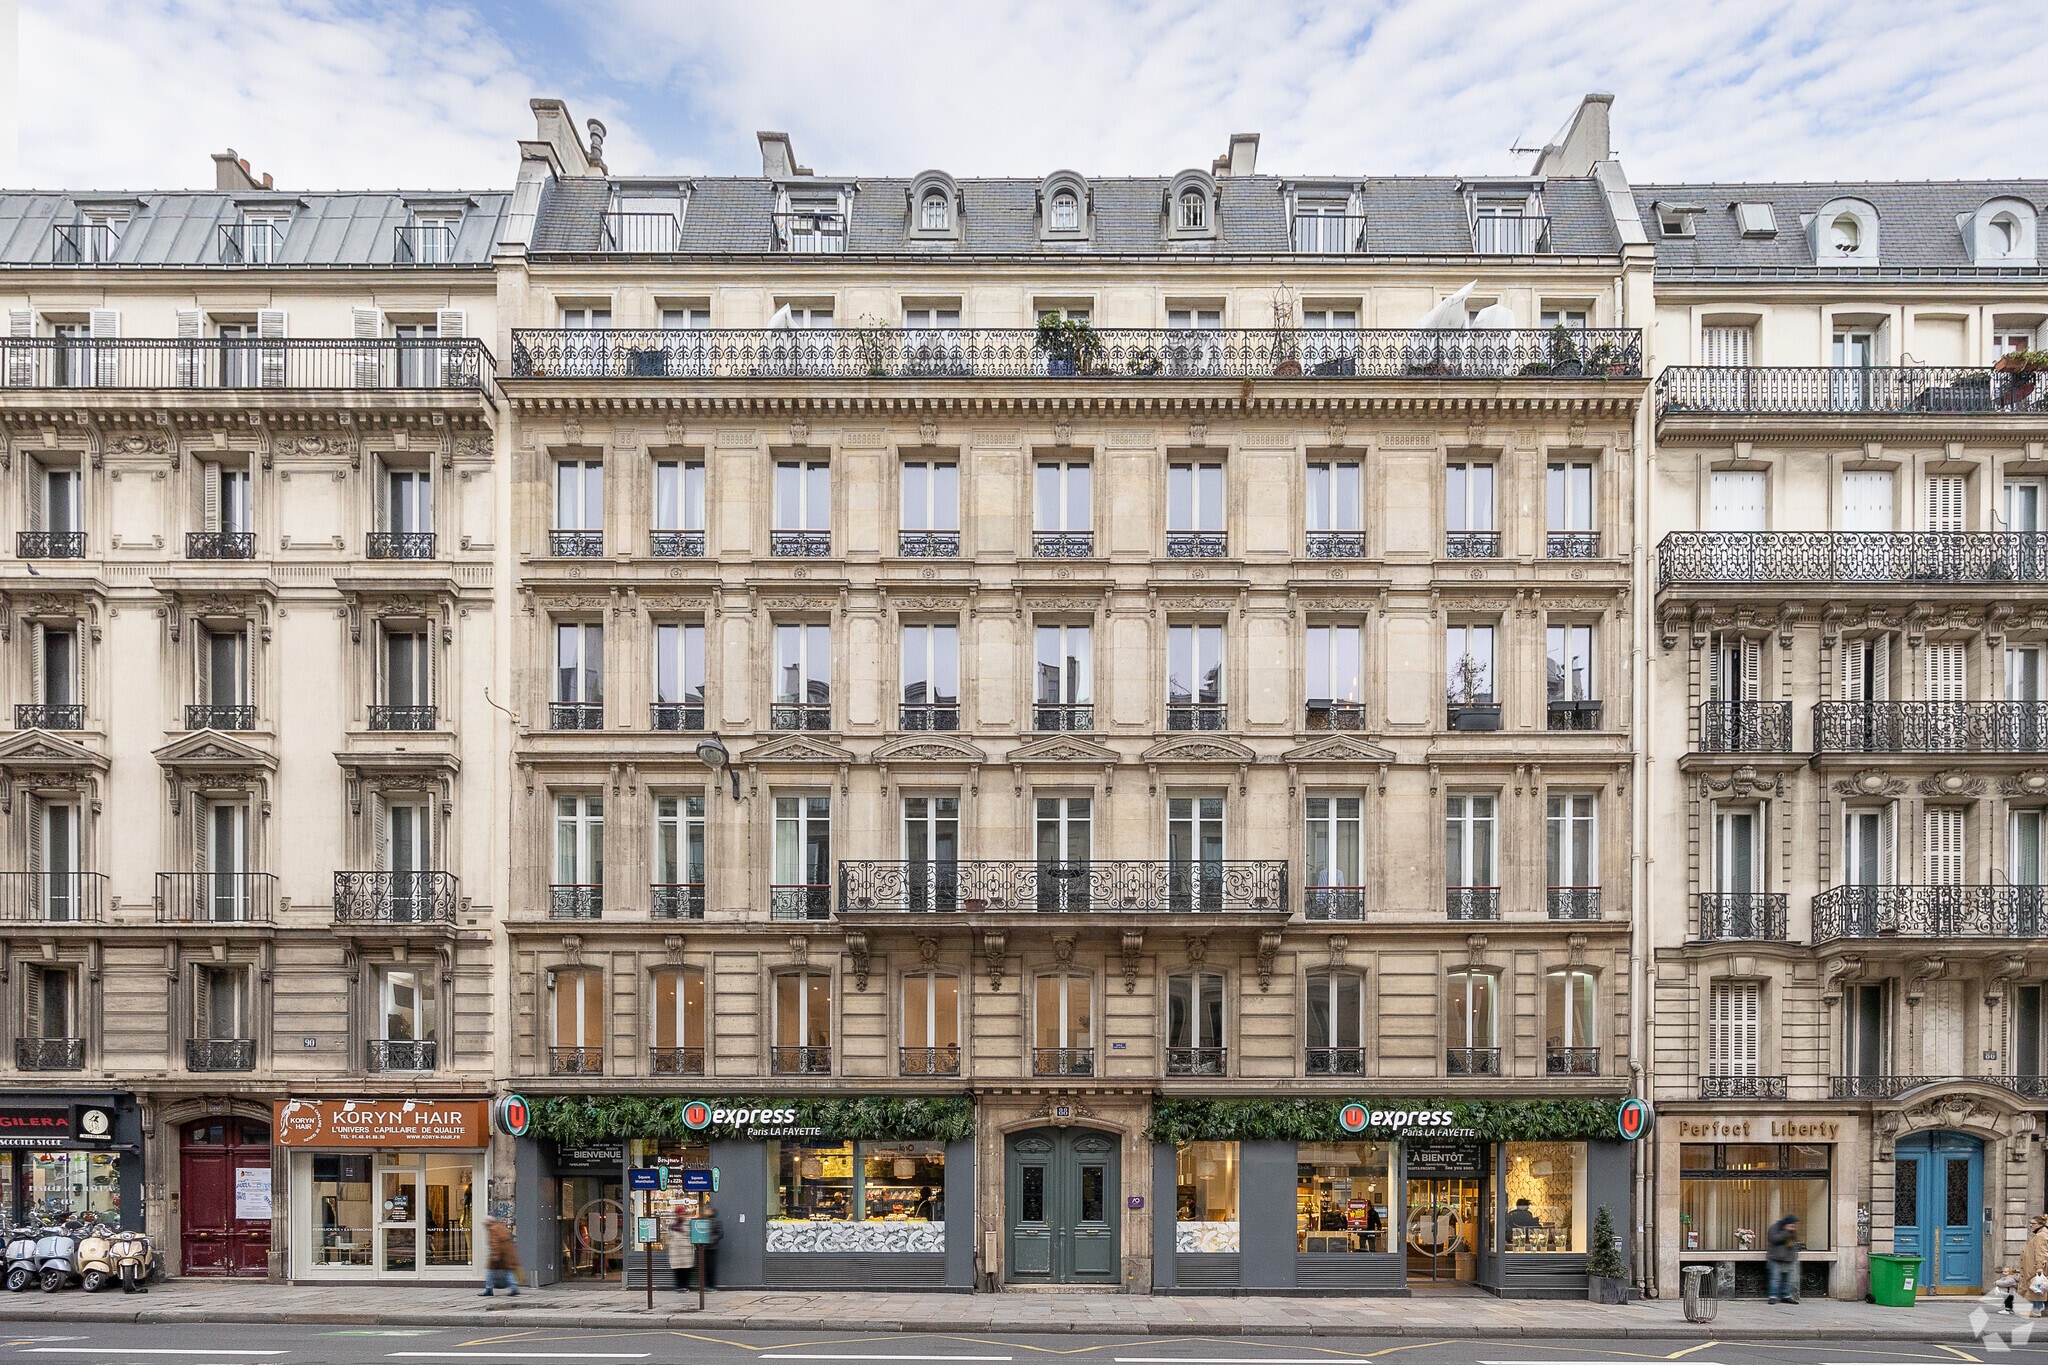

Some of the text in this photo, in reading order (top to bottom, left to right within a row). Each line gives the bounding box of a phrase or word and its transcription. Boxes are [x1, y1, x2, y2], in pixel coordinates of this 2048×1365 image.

[304, 1038, 315, 1047] 90
[510, 1105, 525, 1128] U
[1058, 1107, 1068, 1116] 88
[0, 1117, 69, 1127] GILERA
[333, 1111, 462, 1124] KORYN HAIR
[712, 1108, 796, 1129] express
[1370, 1110, 1453, 1131] express
[1623, 1108, 1639, 1131] U
[373, 1126, 417, 1134] CAPILLAIRE
[421, 1126, 431, 1134] DE
[433, 1126, 466, 1134] QUALITE
[747, 1127, 821, 1136] Paris LA FAYETTE
[1401, 1128, 1475, 1137] Paris LA FAYETTE
[1679, 1120, 1839, 1140] Perfect Liberty
[574, 1151, 622, 1159] BIENVENUE
[1413, 1151, 1420, 1162] À
[1421, 1151, 1464, 1162] BIENTÔT
